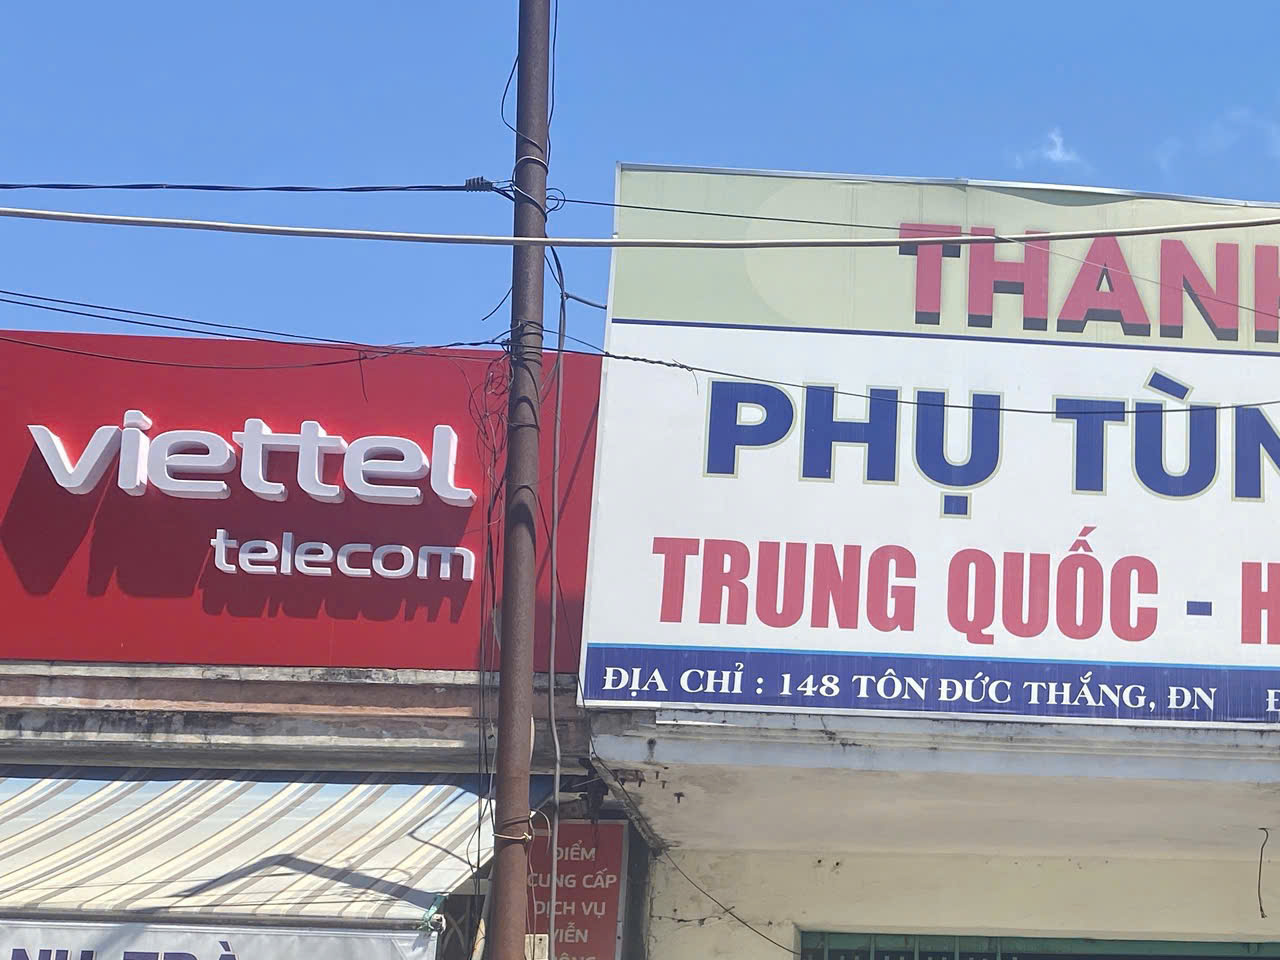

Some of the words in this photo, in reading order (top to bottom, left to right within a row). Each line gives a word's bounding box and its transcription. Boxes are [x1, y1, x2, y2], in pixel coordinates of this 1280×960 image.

[27, 408, 477, 508] viettel
[703, 376, 1005, 519] PHỤ
[209, 528, 475, 582] telecom
[652, 536, 917, 633] TRUNG
[947, 526, 1159, 646] QUỐC
[602, 666, 669, 698] ĐỊA
[679, 662, 745, 694] CHỈ
[779, 673, 840, 697] 148
[852, 668, 929, 701] TÔN
[938, 671, 1012, 704] ĐỨC
[1023, 671, 1156, 713] THẮNG,
[1168, 685, 1218, 712] ĐN
[582, 868, 617, 888] CẤP
[581, 901, 606, 918] VỤ
